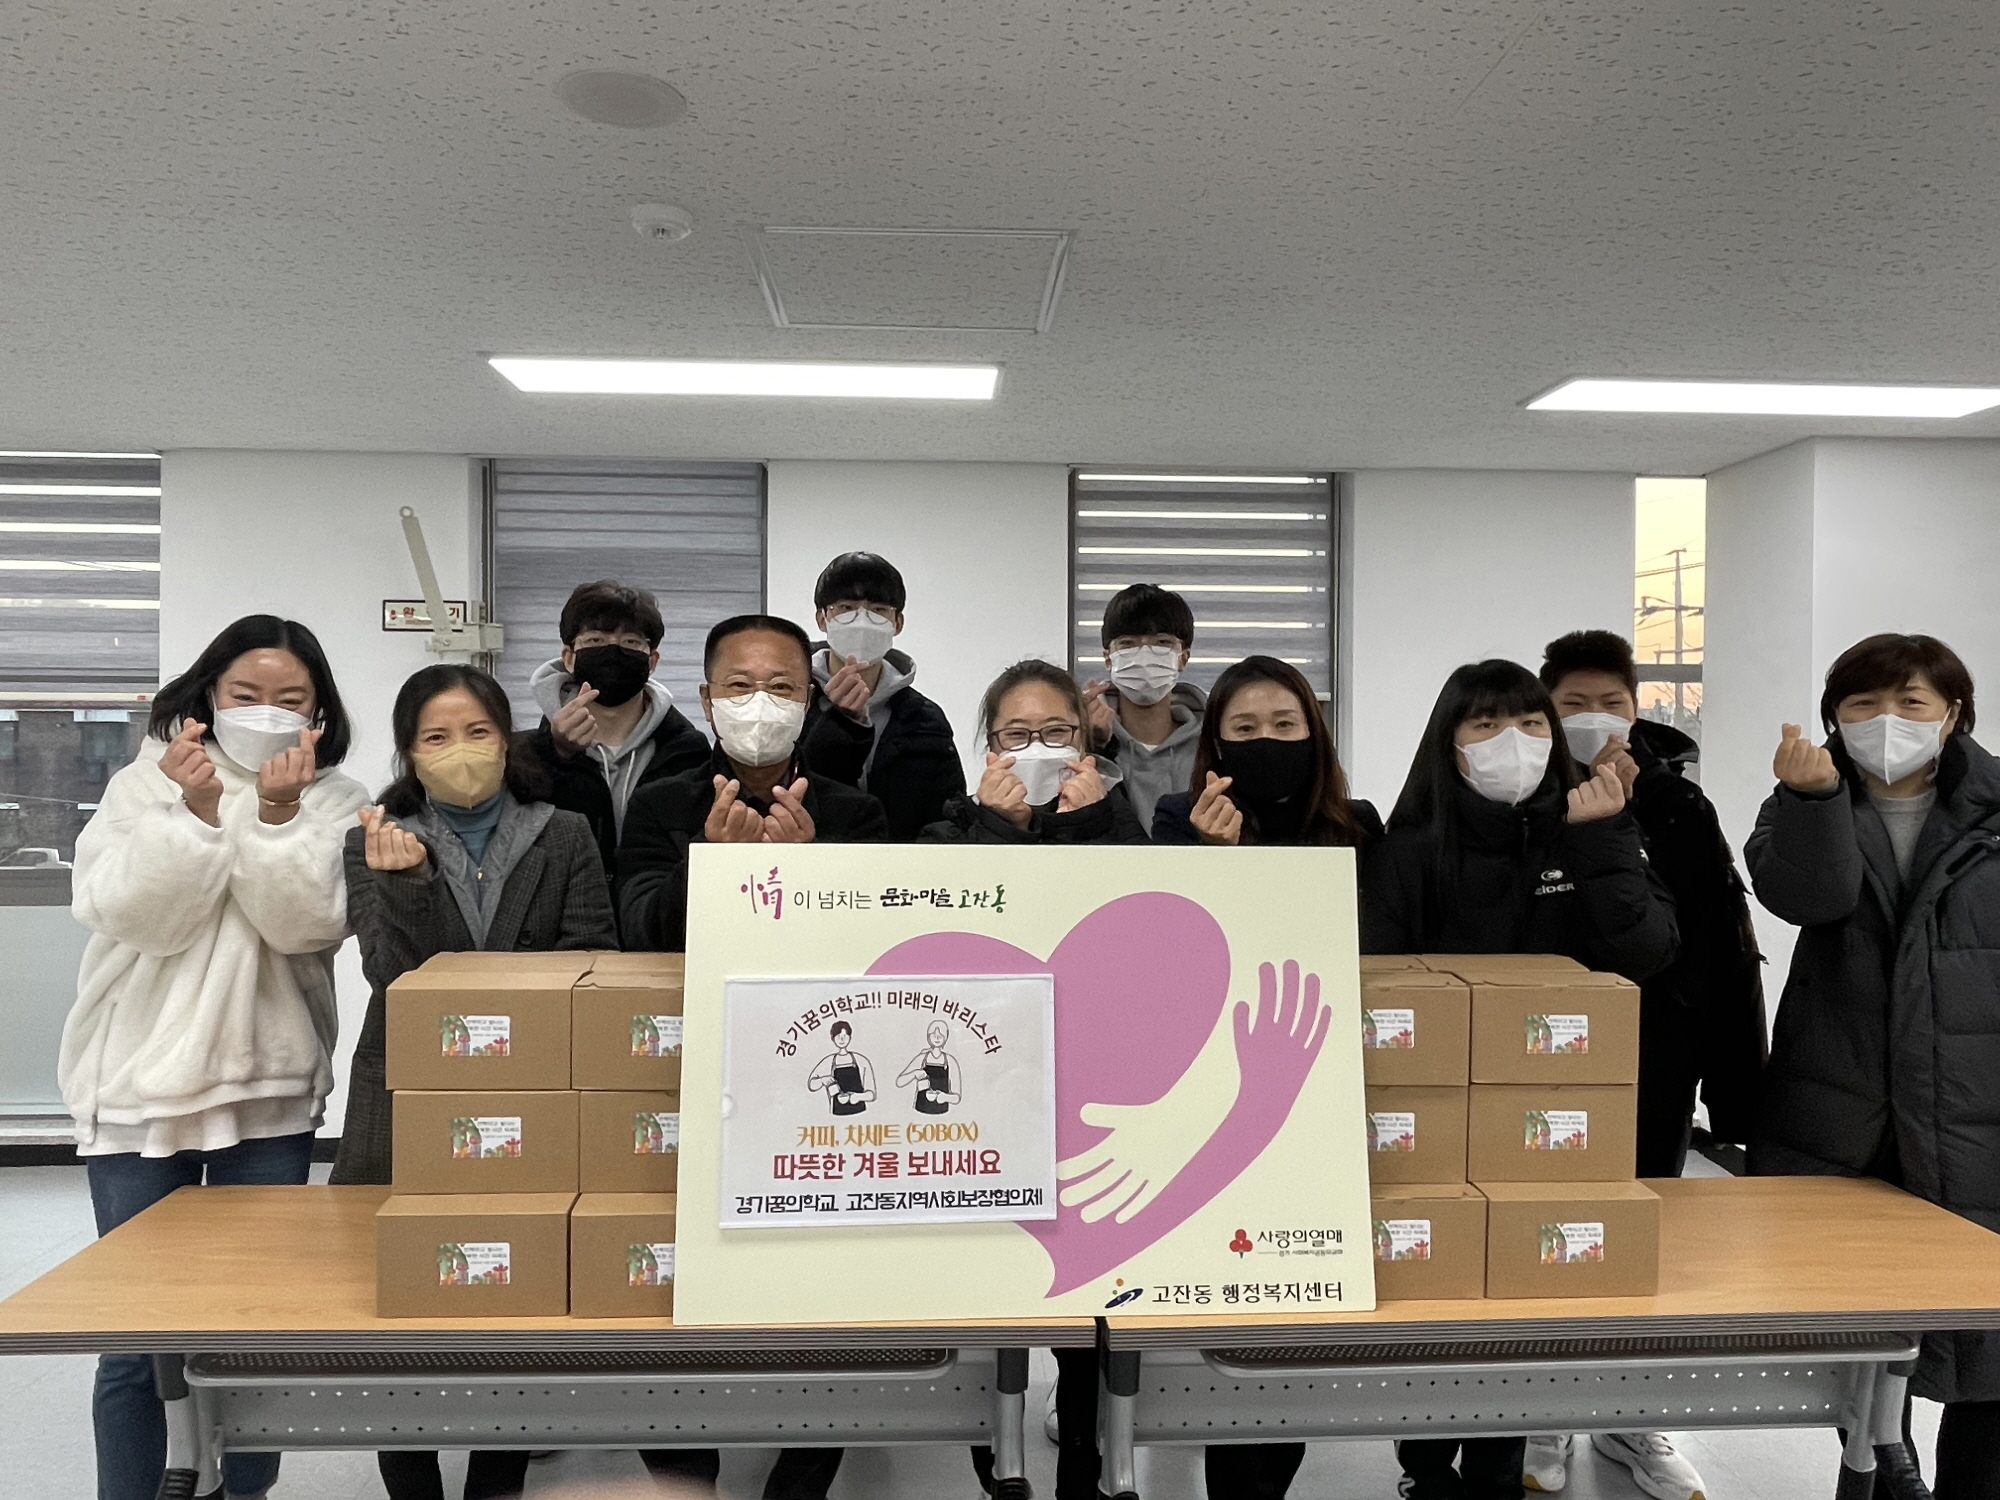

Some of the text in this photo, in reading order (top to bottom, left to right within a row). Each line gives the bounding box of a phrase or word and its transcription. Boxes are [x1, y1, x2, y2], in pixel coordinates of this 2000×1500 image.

[403, 606, 460, 619] 완기
[793, 890, 811, 909] 이
[817, 890, 872, 910] 넘치는
[958, 884, 1007, 914] 고잔동
[775, 990, 1003, 1058] 경기꿈의학교!! 미래의 바리스타
[796, 1121, 979, 1148] 커피, 차세트 (50BOX)
[773, 1149, 1002, 1180] 따뜻한 겨울 보내세요
[735, 1187, 1043, 1214] 경기꿈의학교 고잔동지역사회보장협의체
[1257, 1229, 1342, 1249] 사랑의열매
[1152, 1281, 1343, 1305] 고잔동 행정복지센터
